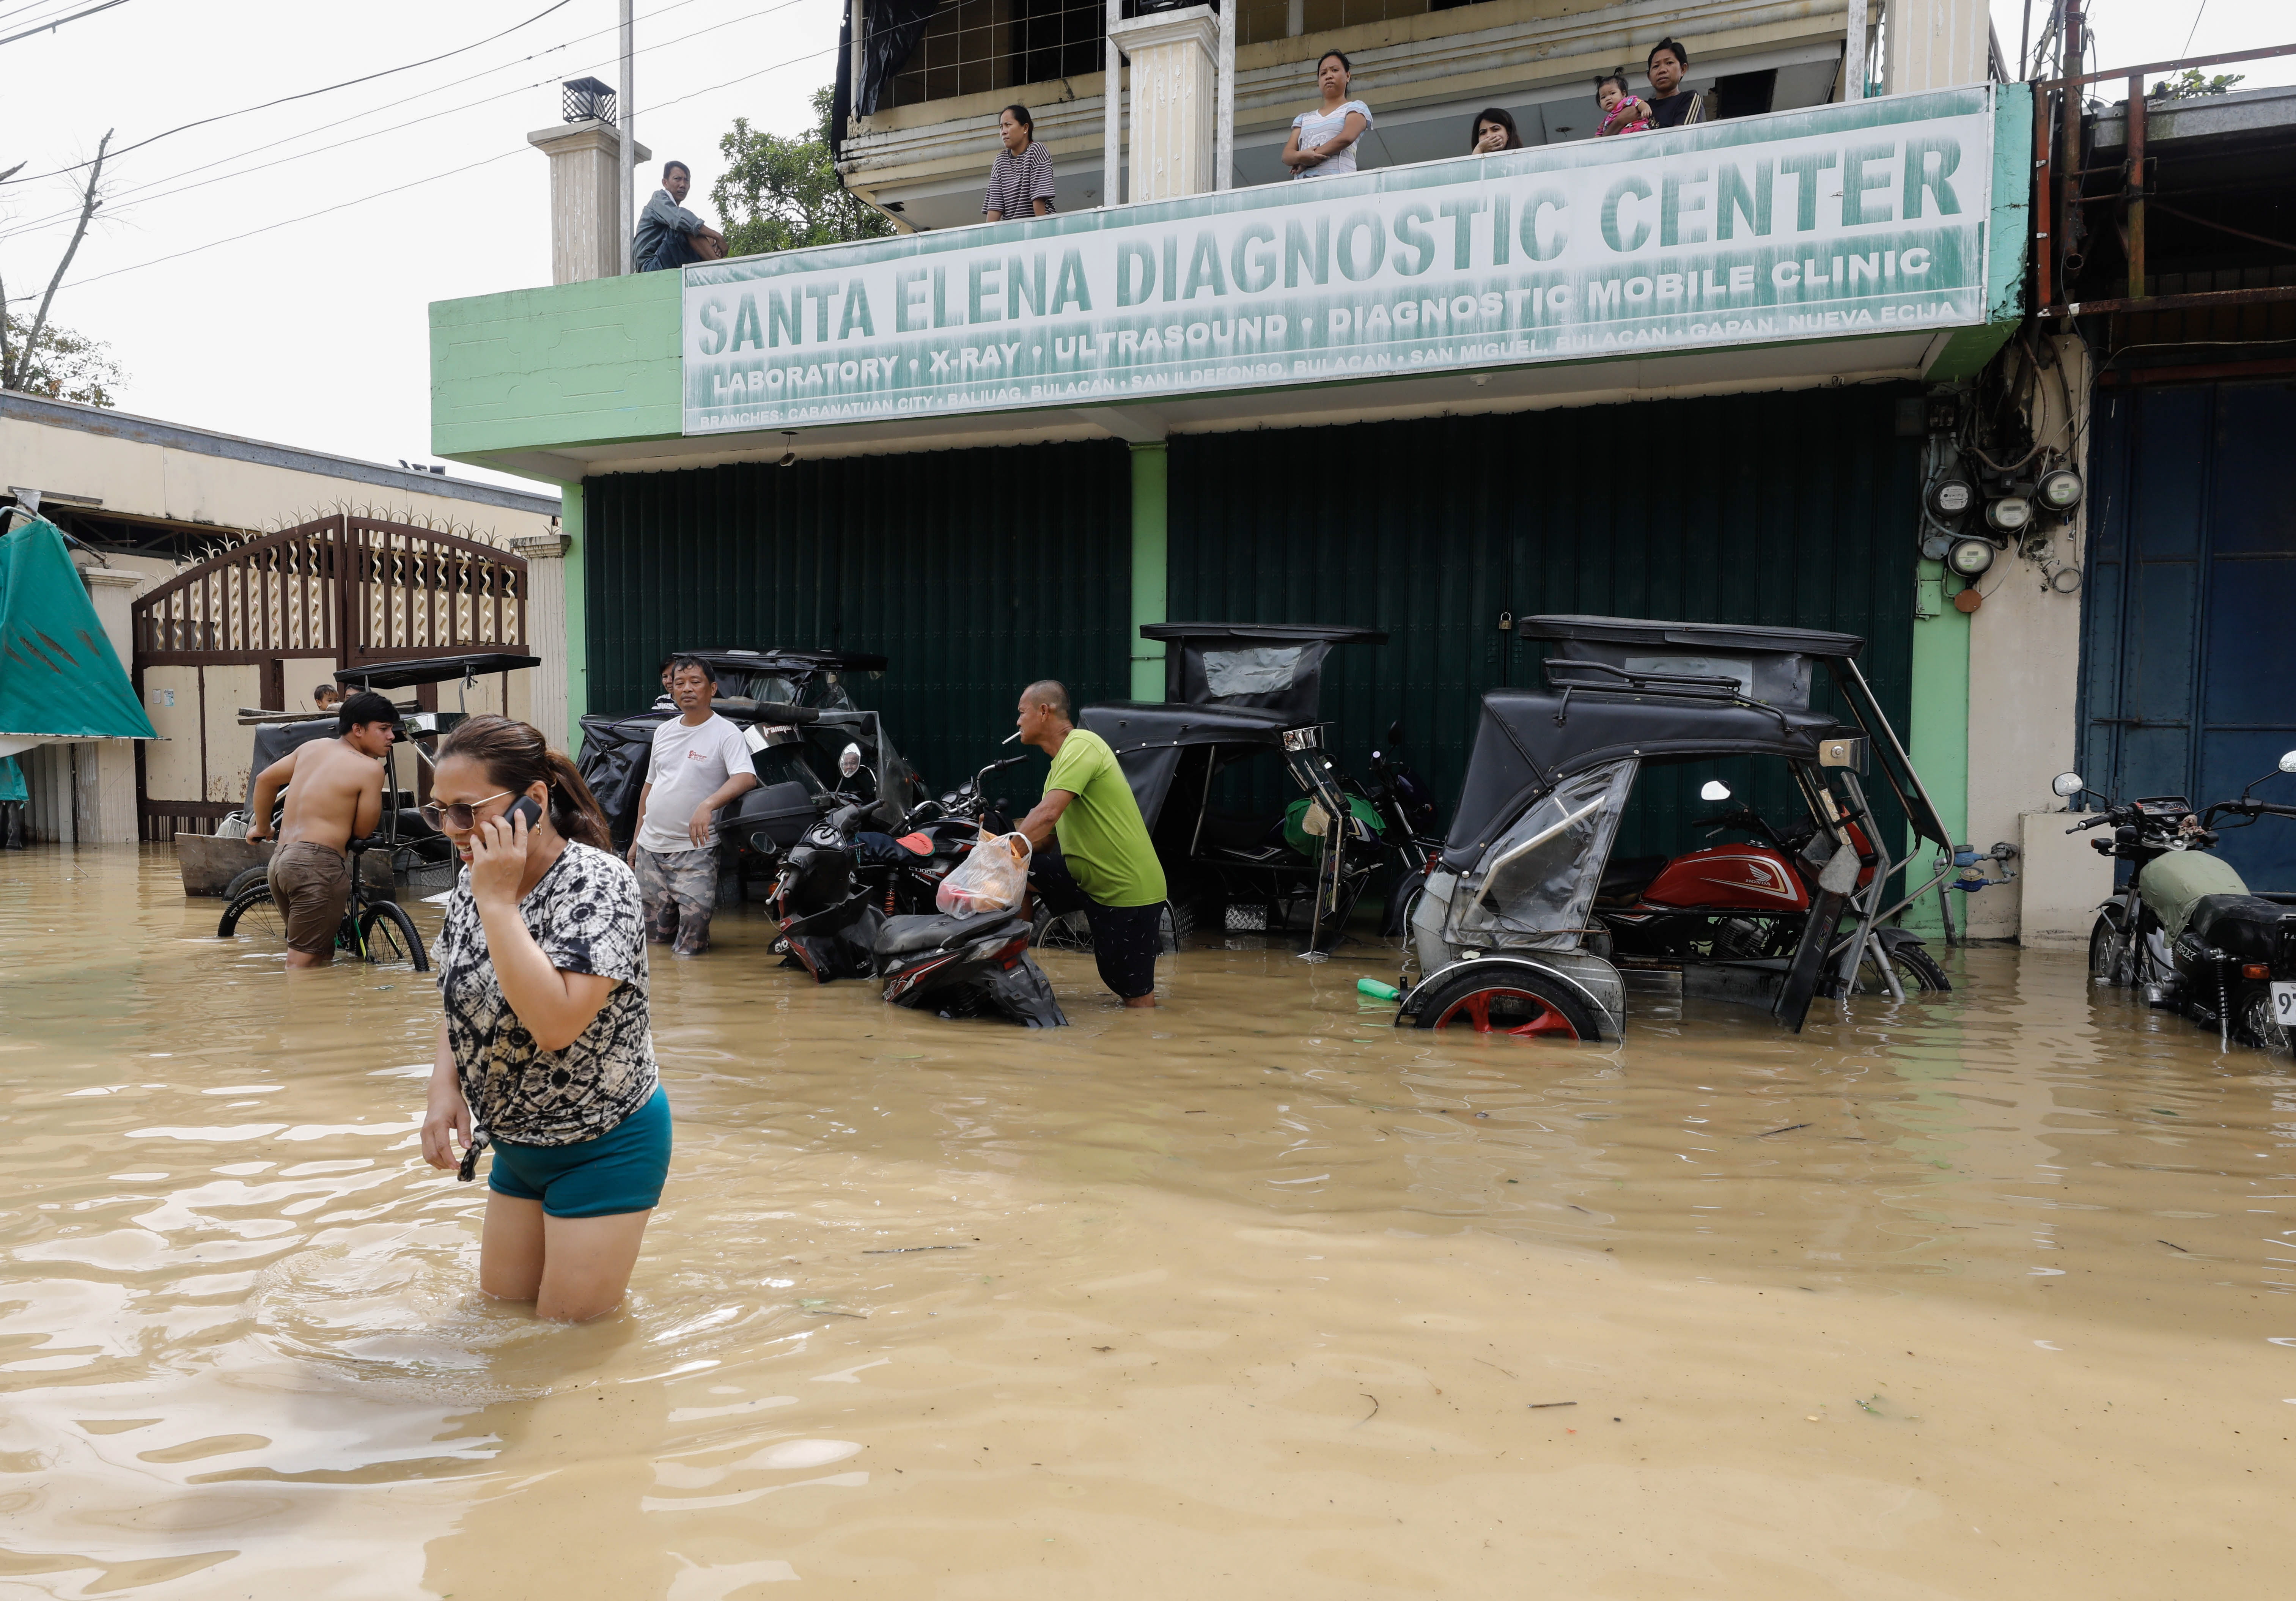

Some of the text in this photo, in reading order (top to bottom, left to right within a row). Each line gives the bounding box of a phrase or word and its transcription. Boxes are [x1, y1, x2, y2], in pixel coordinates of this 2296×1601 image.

[698, 137, 1963, 356] SANTA ELENA DIAGNOSTIC CENTER
[714, 248, 1931, 395] LABORATORY X-RAY ULTRASOUND DIAGNOSTIC MOBILE CLINIC
[700, 409, 783, 428] BRANCHES:
[788, 399, 893, 420] CABANATUAN
[898, 395, 933, 411] CITY
[947, 387, 1025, 406] BALIUAG,
[1031, 378, 1114, 399] BULACAN
[1131, 373, 1168, 389] SAN
[1293, 353, 1390, 373] BULACAN
[1410, 347, 1453, 365] SAN
[1690, 317, 1779, 338] GAPAN,
[1788, 308, 1875, 329] NUEVA
[1881, 302, 1956, 321] ECIJA
[229, 906, 239, 917] CST
[2176, 941, 2197, 961] TMX
[2279, 993, 2296, 1014] 9
